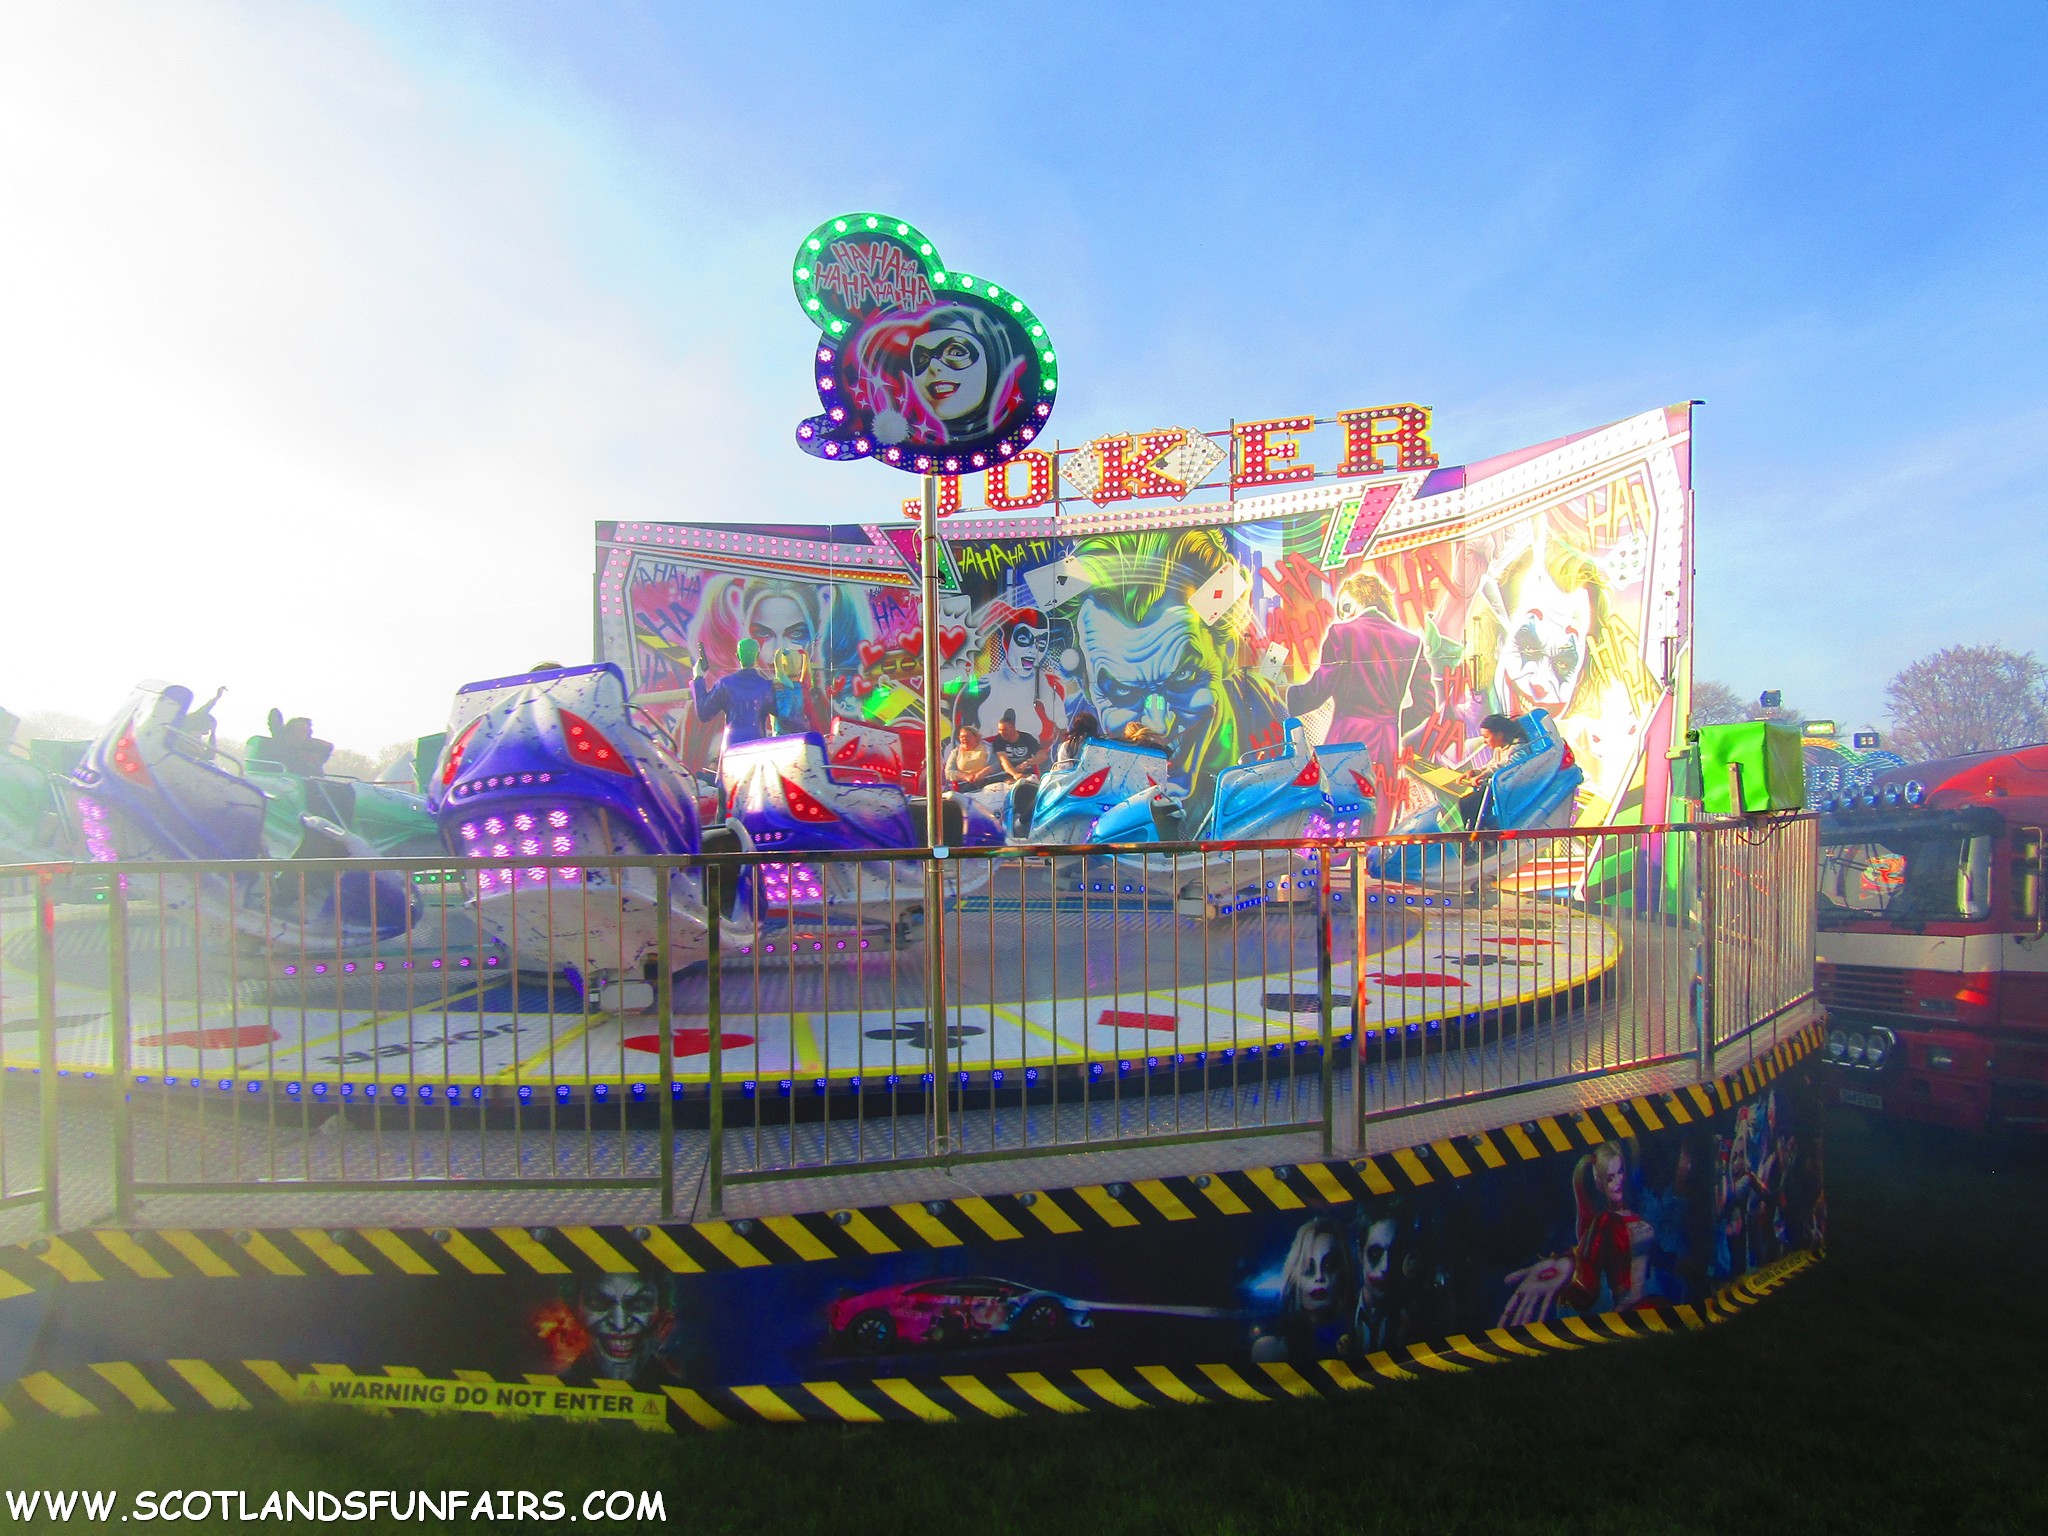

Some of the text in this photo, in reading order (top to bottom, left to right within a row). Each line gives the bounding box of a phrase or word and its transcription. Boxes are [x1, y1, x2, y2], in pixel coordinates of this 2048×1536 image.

[902, 402, 1439, 520] JOKER
[1419, 711, 1466, 761] HA
[330, 1381, 634, 1413] WARNING DO NOT ENTER
